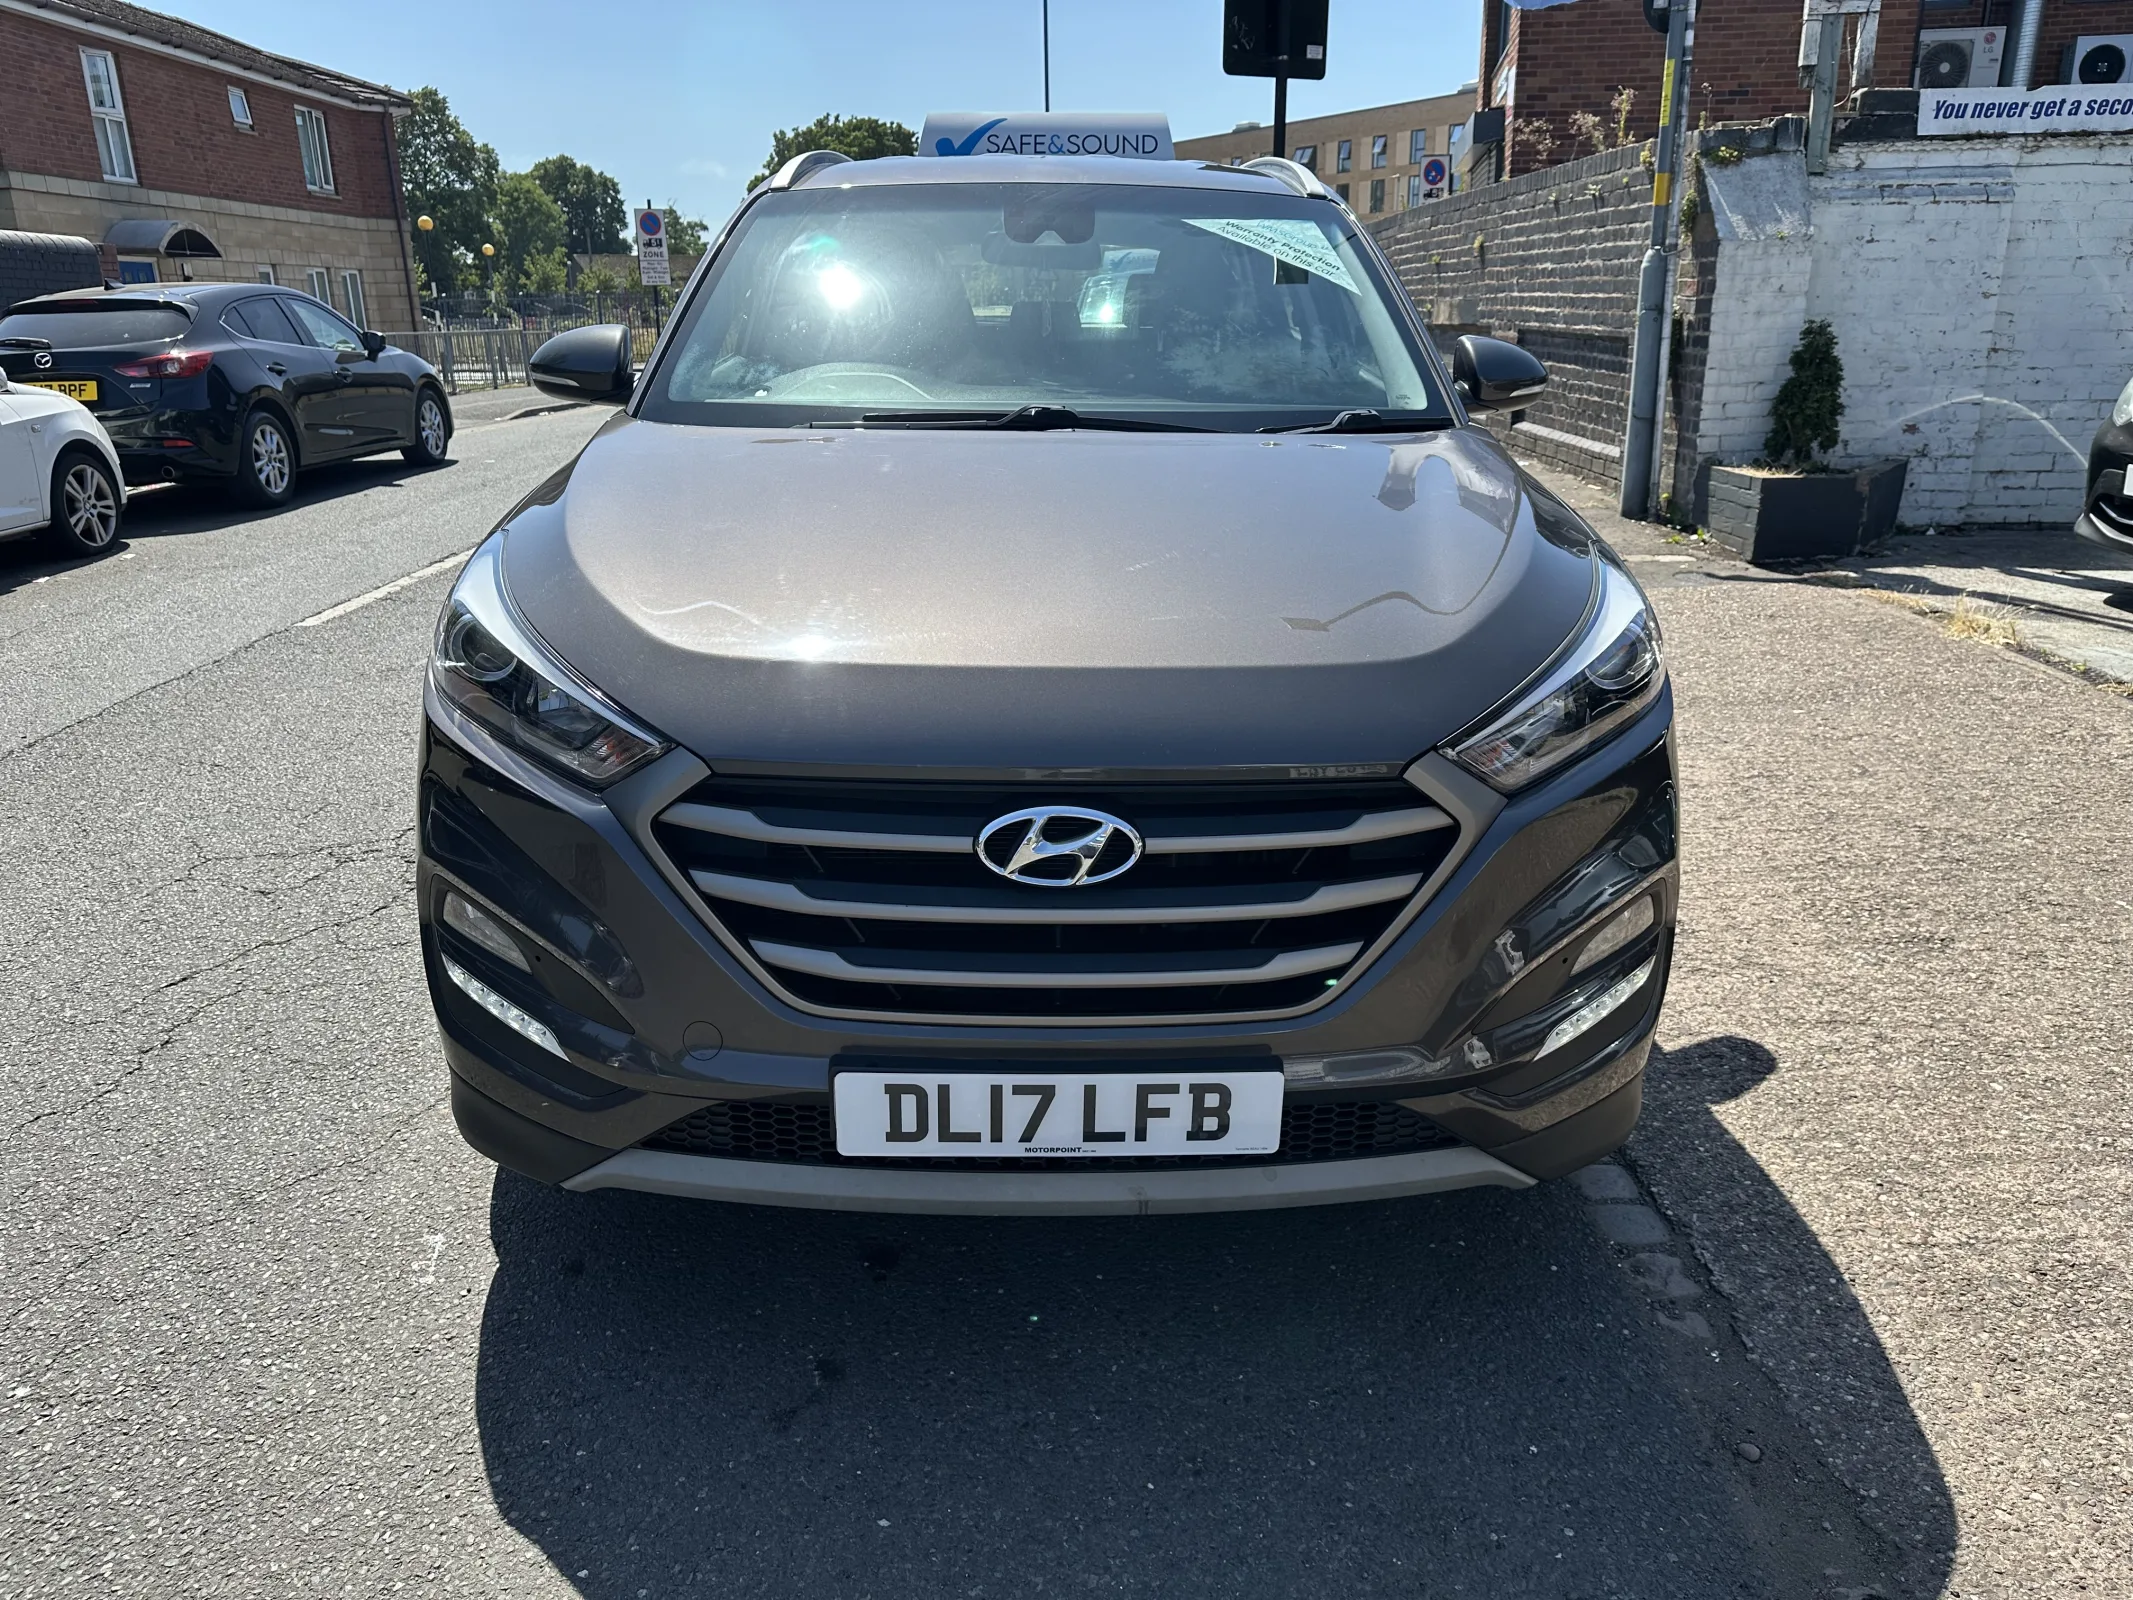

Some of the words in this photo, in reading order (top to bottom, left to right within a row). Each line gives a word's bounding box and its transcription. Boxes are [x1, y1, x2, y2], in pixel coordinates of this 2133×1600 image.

[1933, 100, 1969, 120] You
[1970, 100, 2030, 119] never
[2030, 98, 2067, 120] get
[2067, 99, 2082, 116] a
[2085, 98, 2133, 116] seco
[986, 134, 1159, 154] SAFE&SOUND
[1216, 226, 1271, 250] Available
[1273, 248, 1290, 258] on
[1291, 254, 1313, 268] this
[1315, 264, 1336, 277] car
[1226, 221, 1279, 244] Warranty
[1281, 242, 1341, 272] Protection
[884, 1083, 1057, 1143] DL17
[1083, 1083, 1232, 1143] LFB
